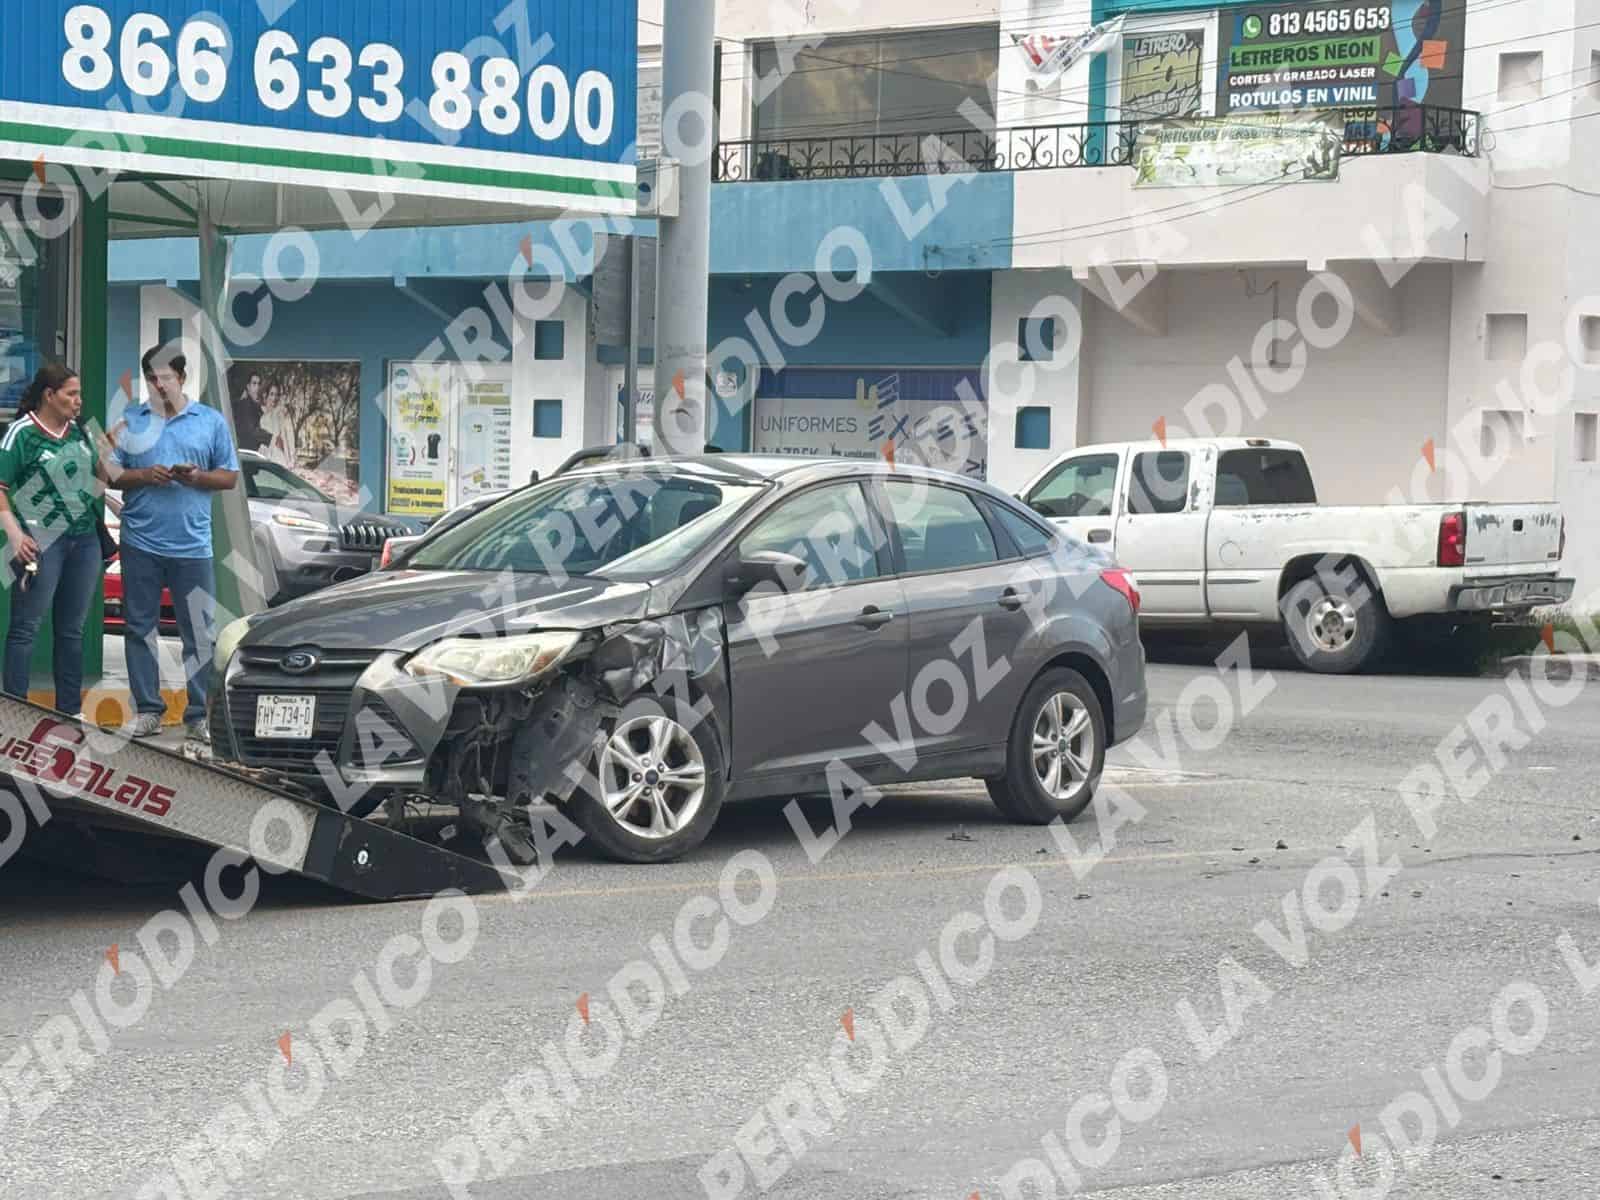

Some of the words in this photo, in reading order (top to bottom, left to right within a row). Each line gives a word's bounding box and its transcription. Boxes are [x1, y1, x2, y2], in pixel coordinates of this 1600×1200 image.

[1269, 12, 1300, 36] 813
[1304, 9, 1350, 33] 4565
[1354, 7, 1390, 30] 653
[1231, 45, 1321, 67] LETREROS
[1324, 40, 1374, 61] NEON
[62, 5, 227, 103] 866
[254, 30, 404, 124] 633
[430, 51, 615, 146] 8800
[1229, 73, 1272, 87] CORTES
[1271, 72, 1281, 83] Y
[1283, 68, 1337, 82] GRABADO
[1339, 67, 1376, 80] LASER
[1229, 89, 1302, 108] ROTULOS
[1306, 88, 1328, 103] EN
[1332, 85, 1377, 102] VINIL
[760, 415, 858, 433] UNIFORMES
